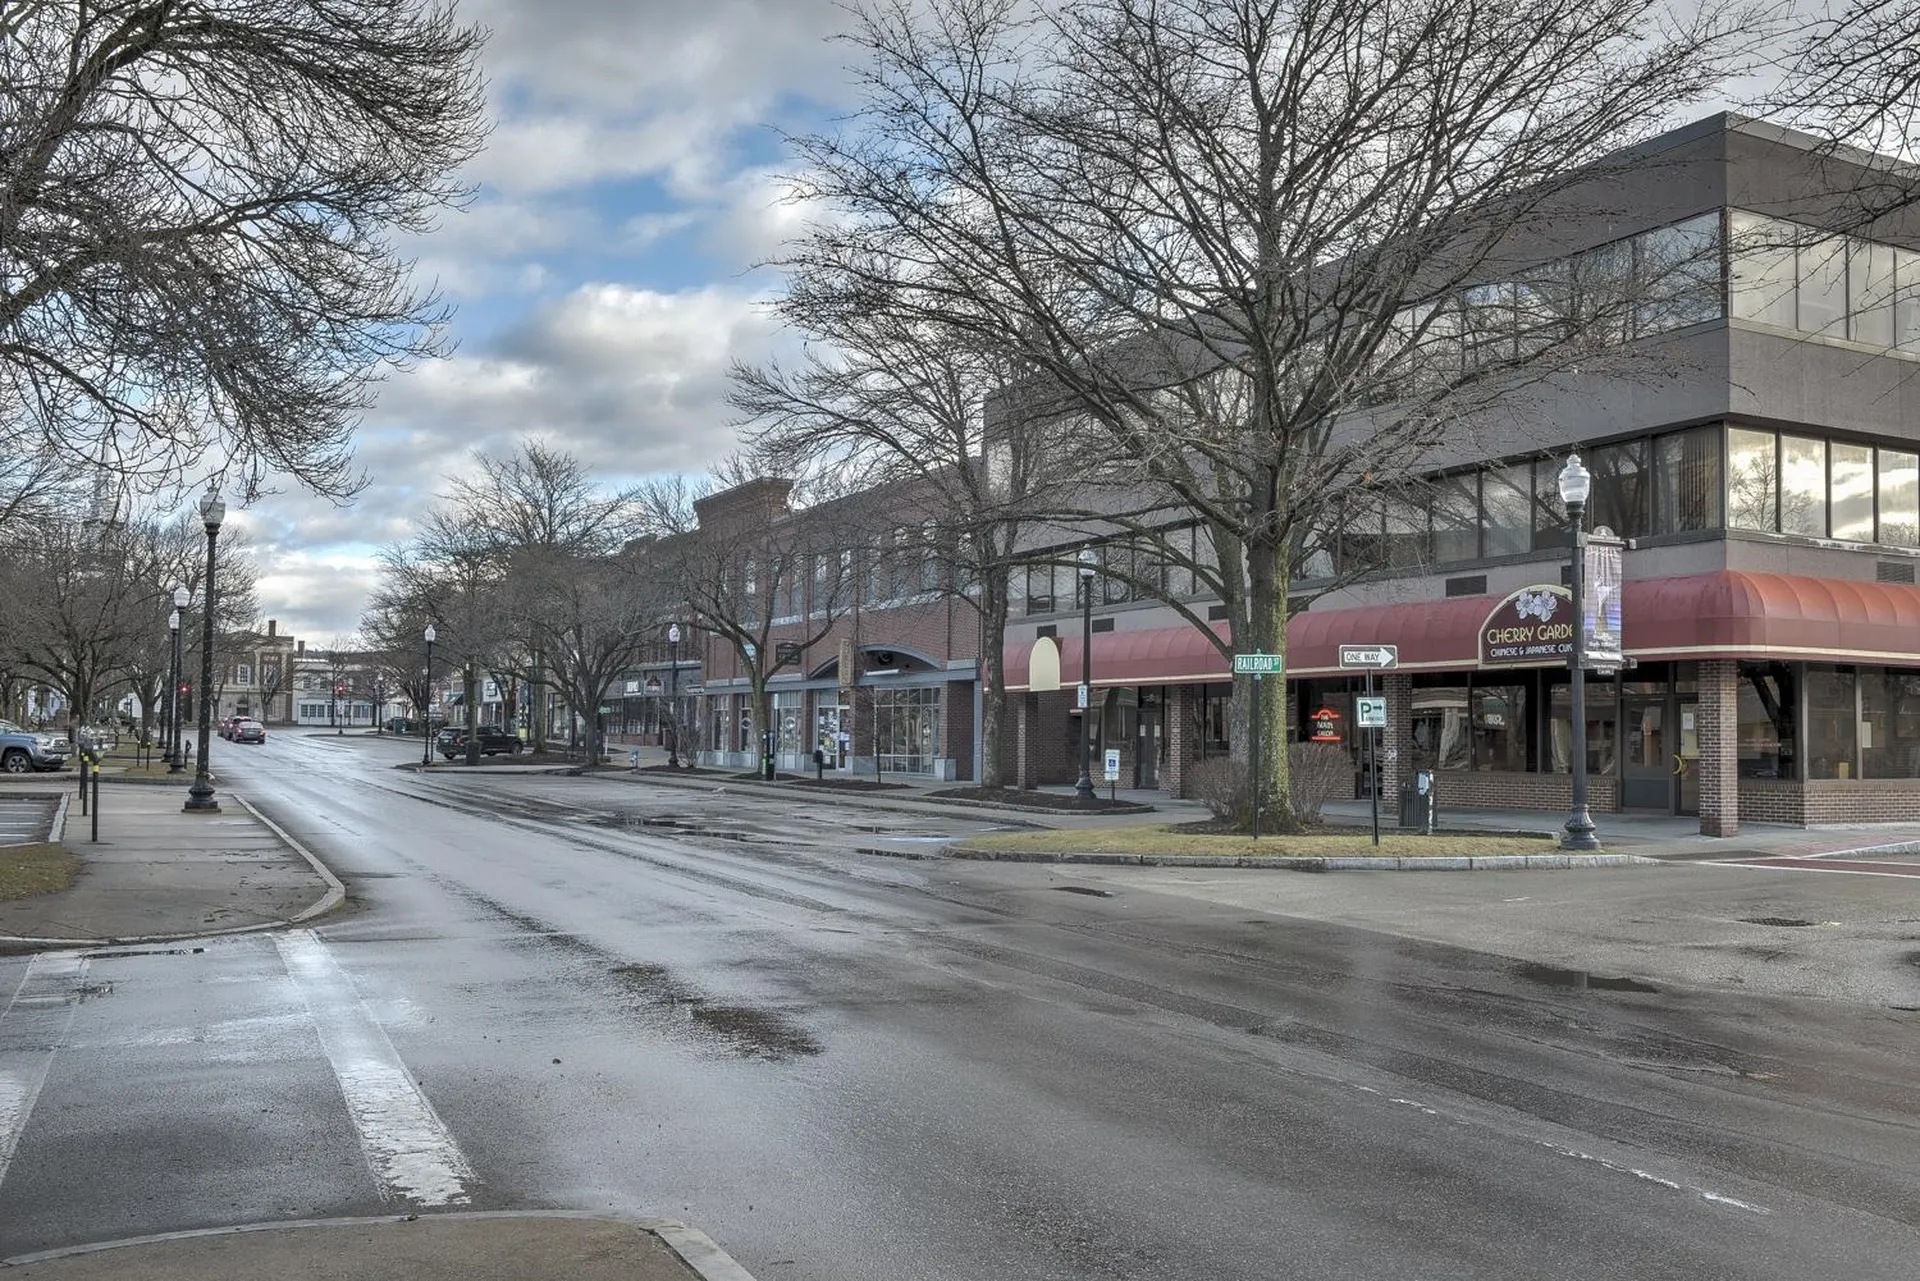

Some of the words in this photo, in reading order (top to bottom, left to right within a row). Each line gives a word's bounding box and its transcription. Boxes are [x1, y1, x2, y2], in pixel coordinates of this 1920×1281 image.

[1487, 626, 1534, 644] CHERRY
[1346, 652, 1362, 661] ONE
[1364, 652, 1380, 661] WAY
[1237, 657, 1273, 670] RAILROAD
